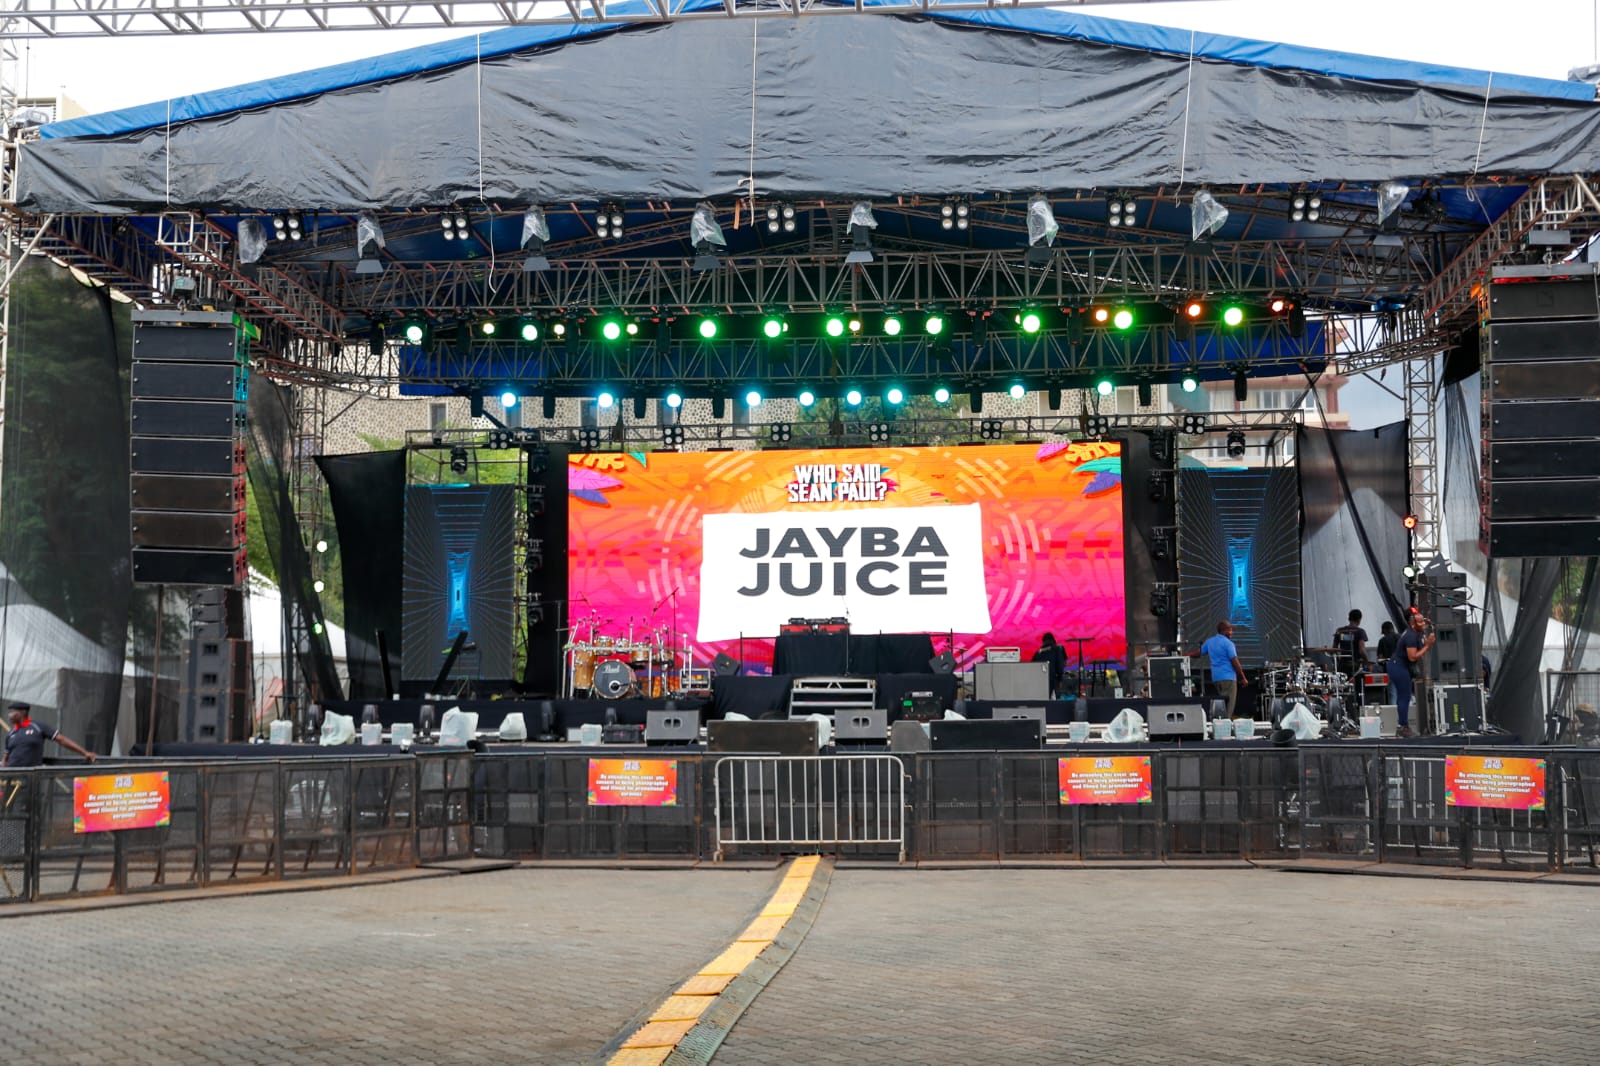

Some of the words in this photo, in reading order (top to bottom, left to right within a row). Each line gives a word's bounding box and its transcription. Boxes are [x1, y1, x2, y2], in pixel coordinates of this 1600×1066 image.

[794, 464, 836, 484] WHO
[842, 464, 881, 483] SAID
[788, 483, 834, 502] SEAN
[838, 482, 888, 502] PAUL?
[738, 526, 950, 558] JAYBA
[736, 561, 948, 597] JUICE
